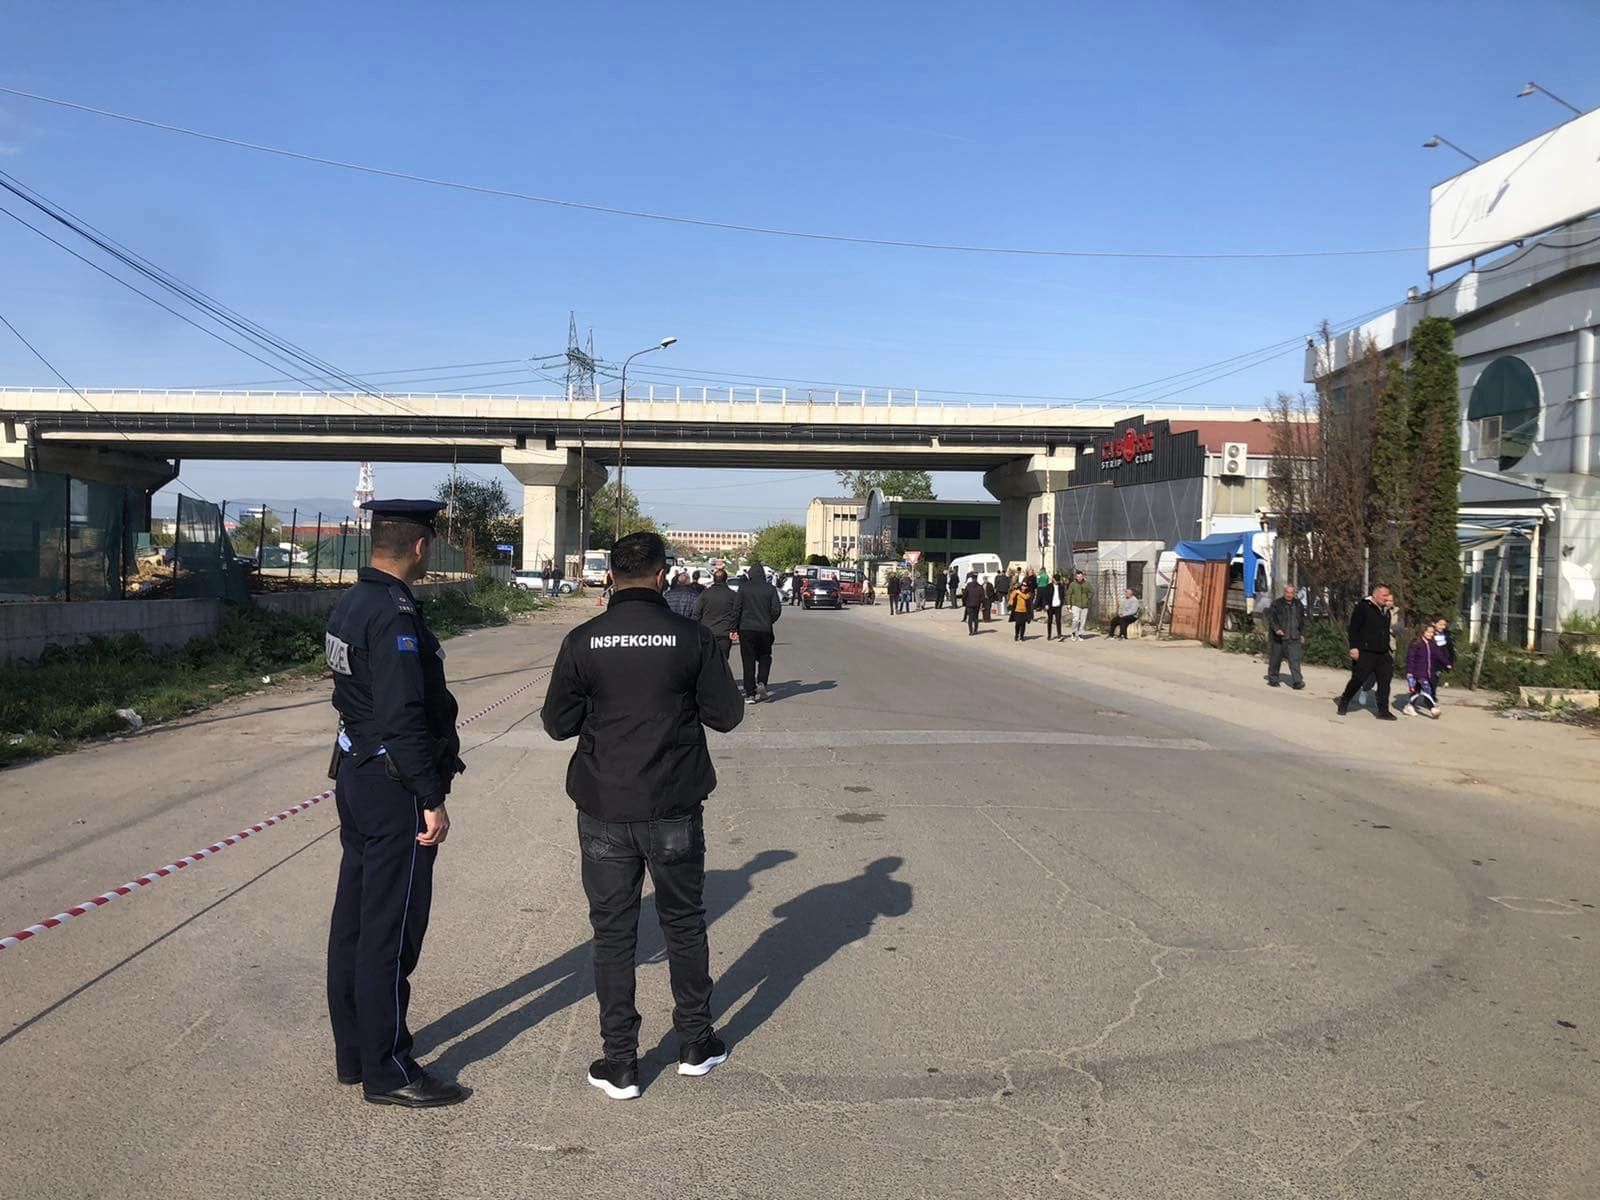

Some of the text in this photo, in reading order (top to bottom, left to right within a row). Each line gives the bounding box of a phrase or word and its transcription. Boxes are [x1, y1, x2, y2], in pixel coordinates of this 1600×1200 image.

[1101, 453, 1153, 469] STRIP CLUB
[590, 634, 677, 649] INSPEKCIONI
